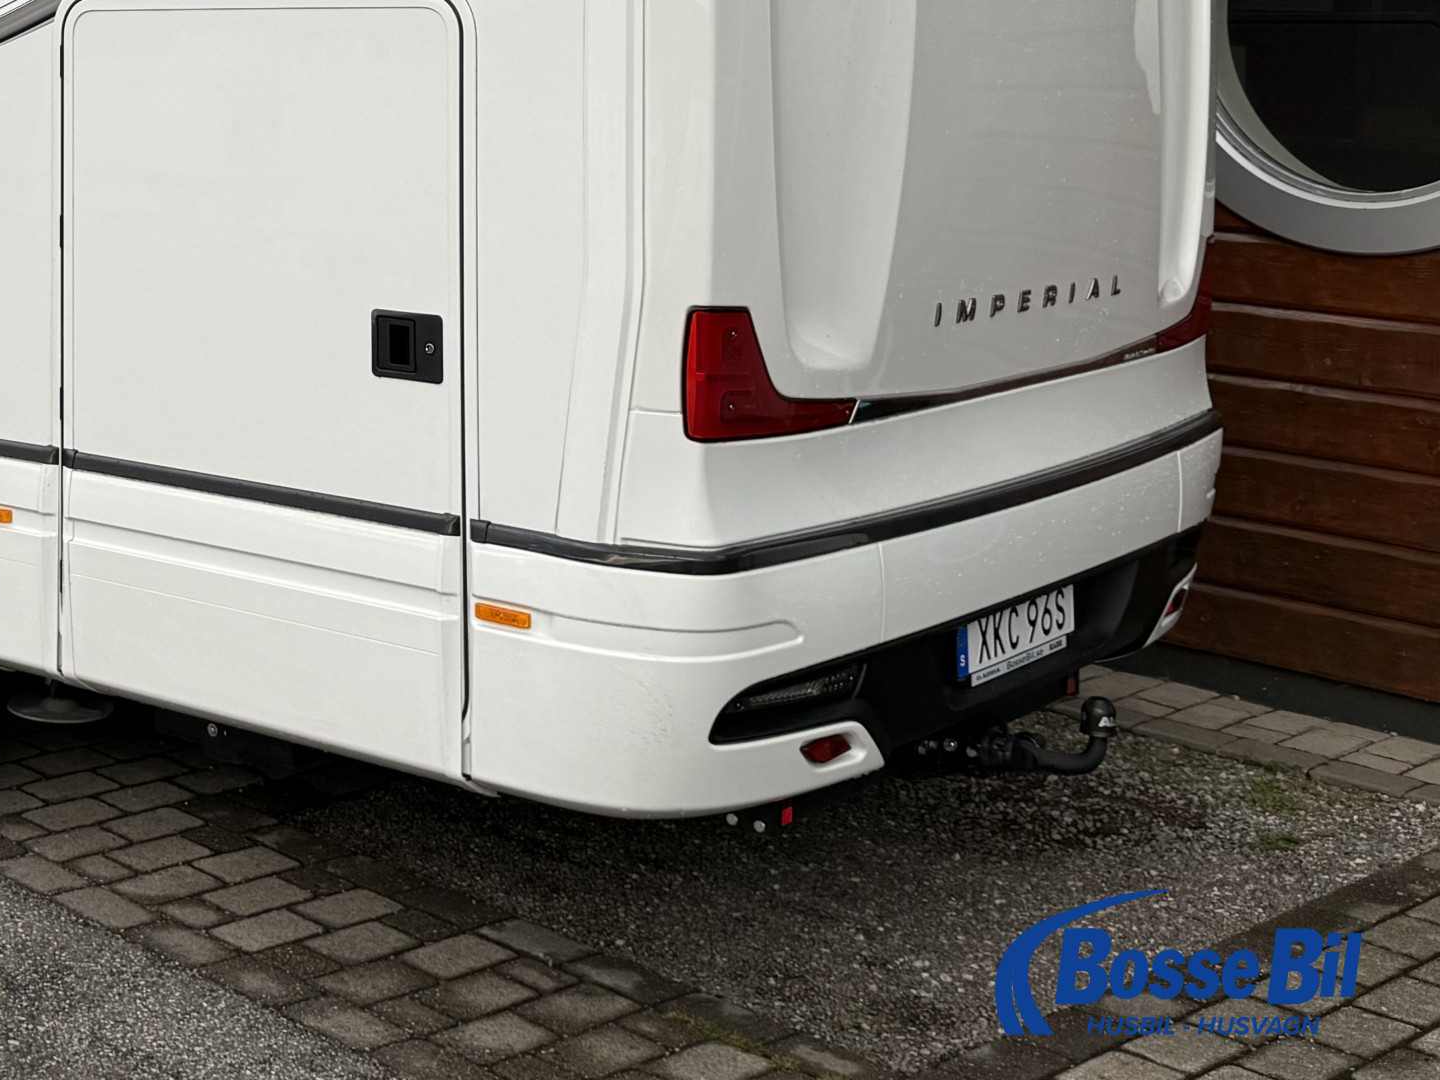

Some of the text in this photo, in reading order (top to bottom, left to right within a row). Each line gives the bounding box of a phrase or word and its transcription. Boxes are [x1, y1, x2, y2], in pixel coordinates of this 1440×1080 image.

[934, 274, 1121, 327] IMPERIAL
[977, 588, 1066, 664] XKC 96S
[960, 654, 966, 667] S
